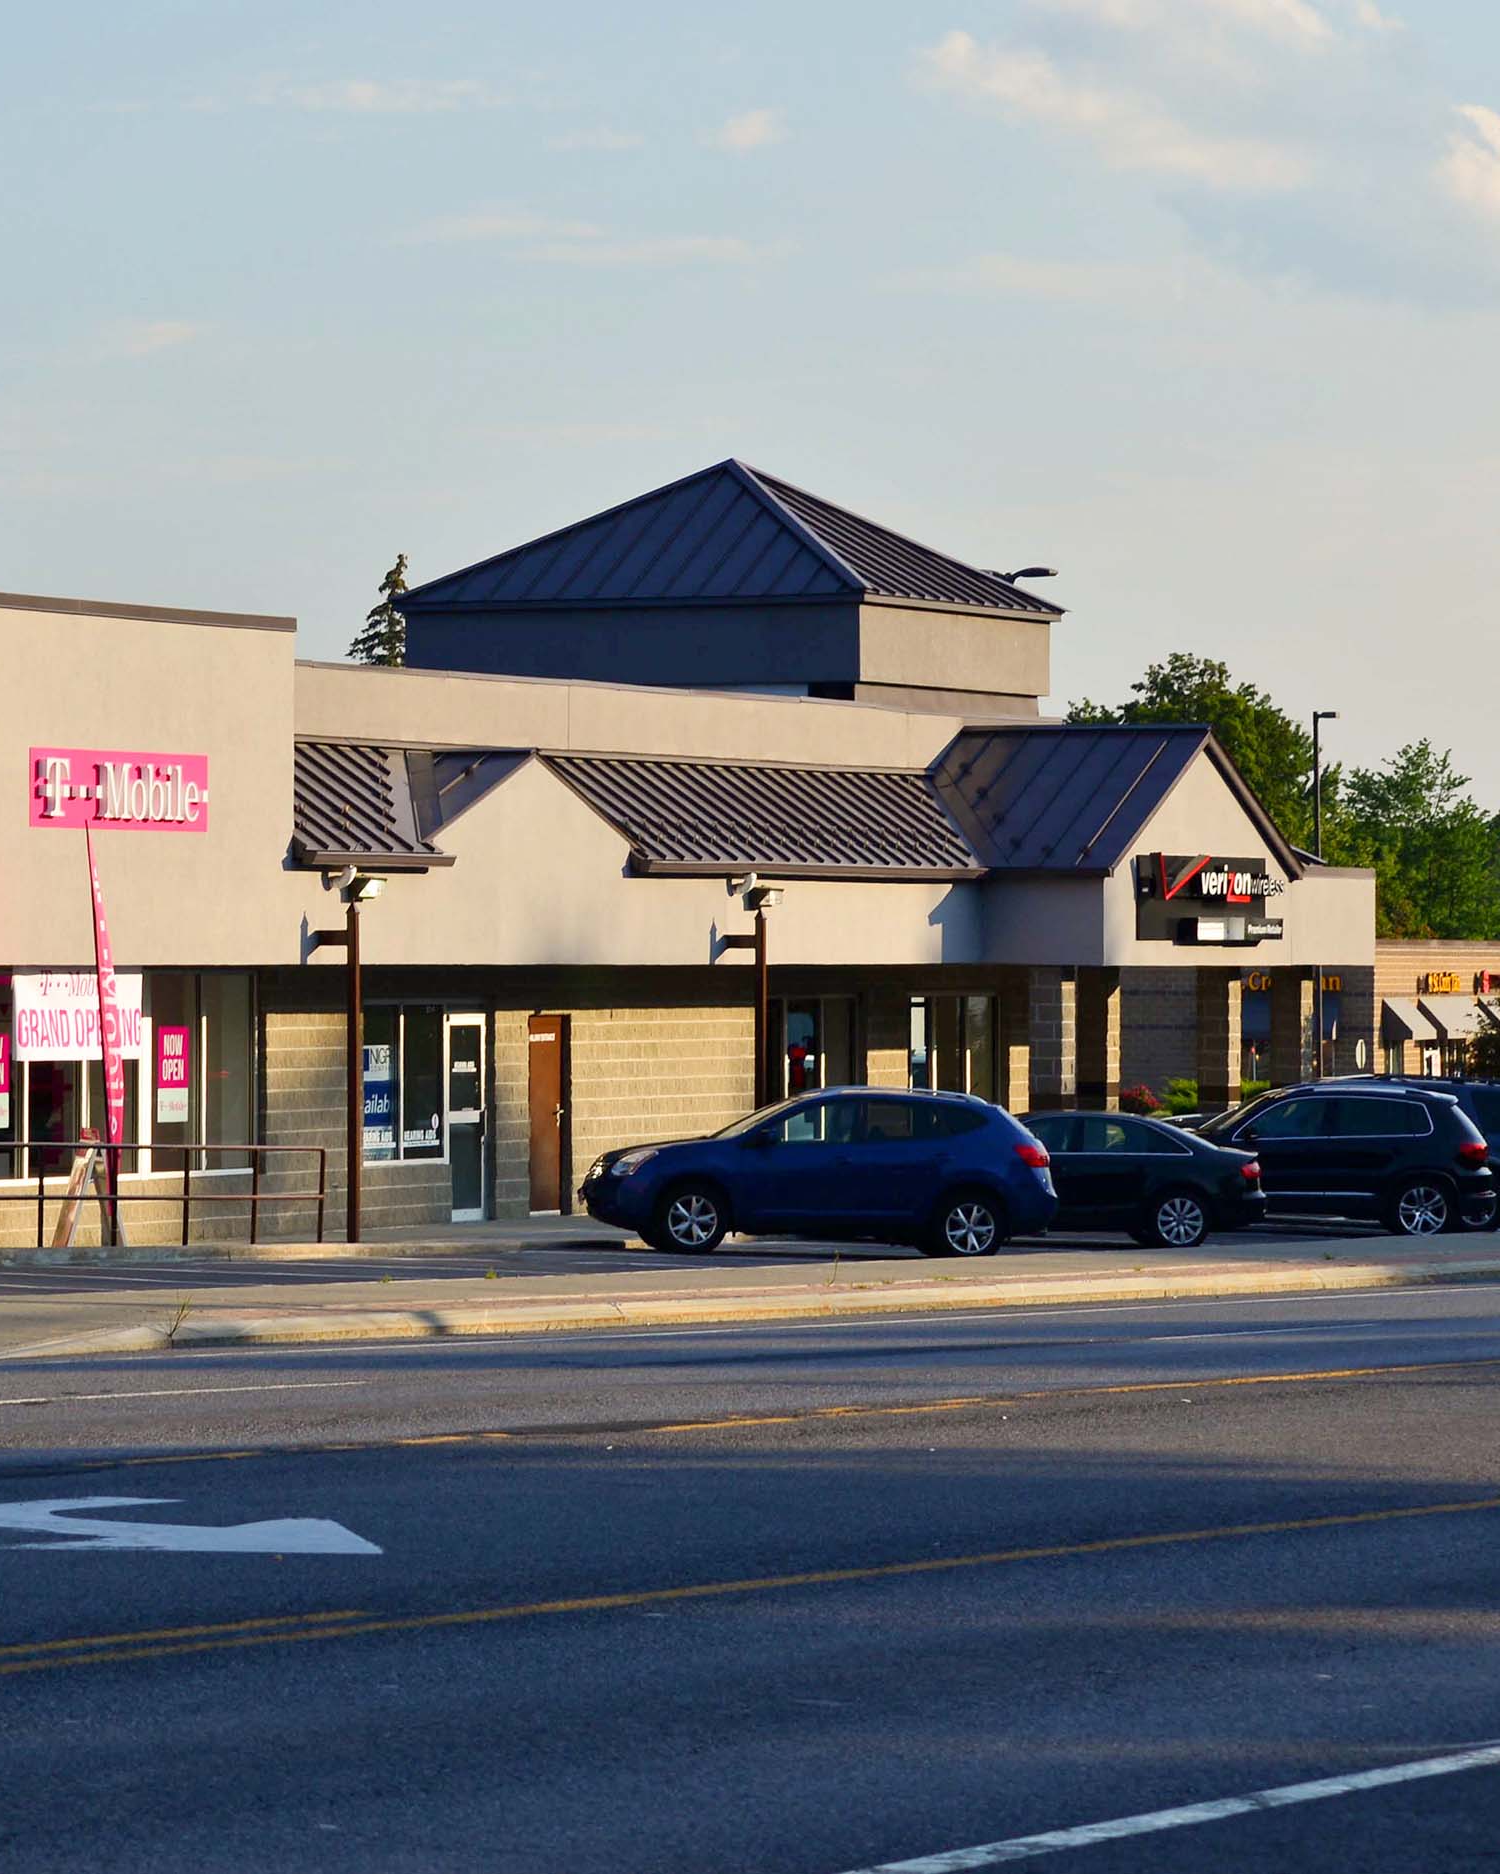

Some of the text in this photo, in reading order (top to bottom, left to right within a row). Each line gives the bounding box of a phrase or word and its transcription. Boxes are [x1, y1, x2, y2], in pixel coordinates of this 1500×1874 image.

[1201, 864, 1252, 902] verizon
[17, 1008, 141, 1048] GRAND OPENG
[163, 1034, 183, 1056] NOW
[162, 1059, 184, 1081] OPEN
